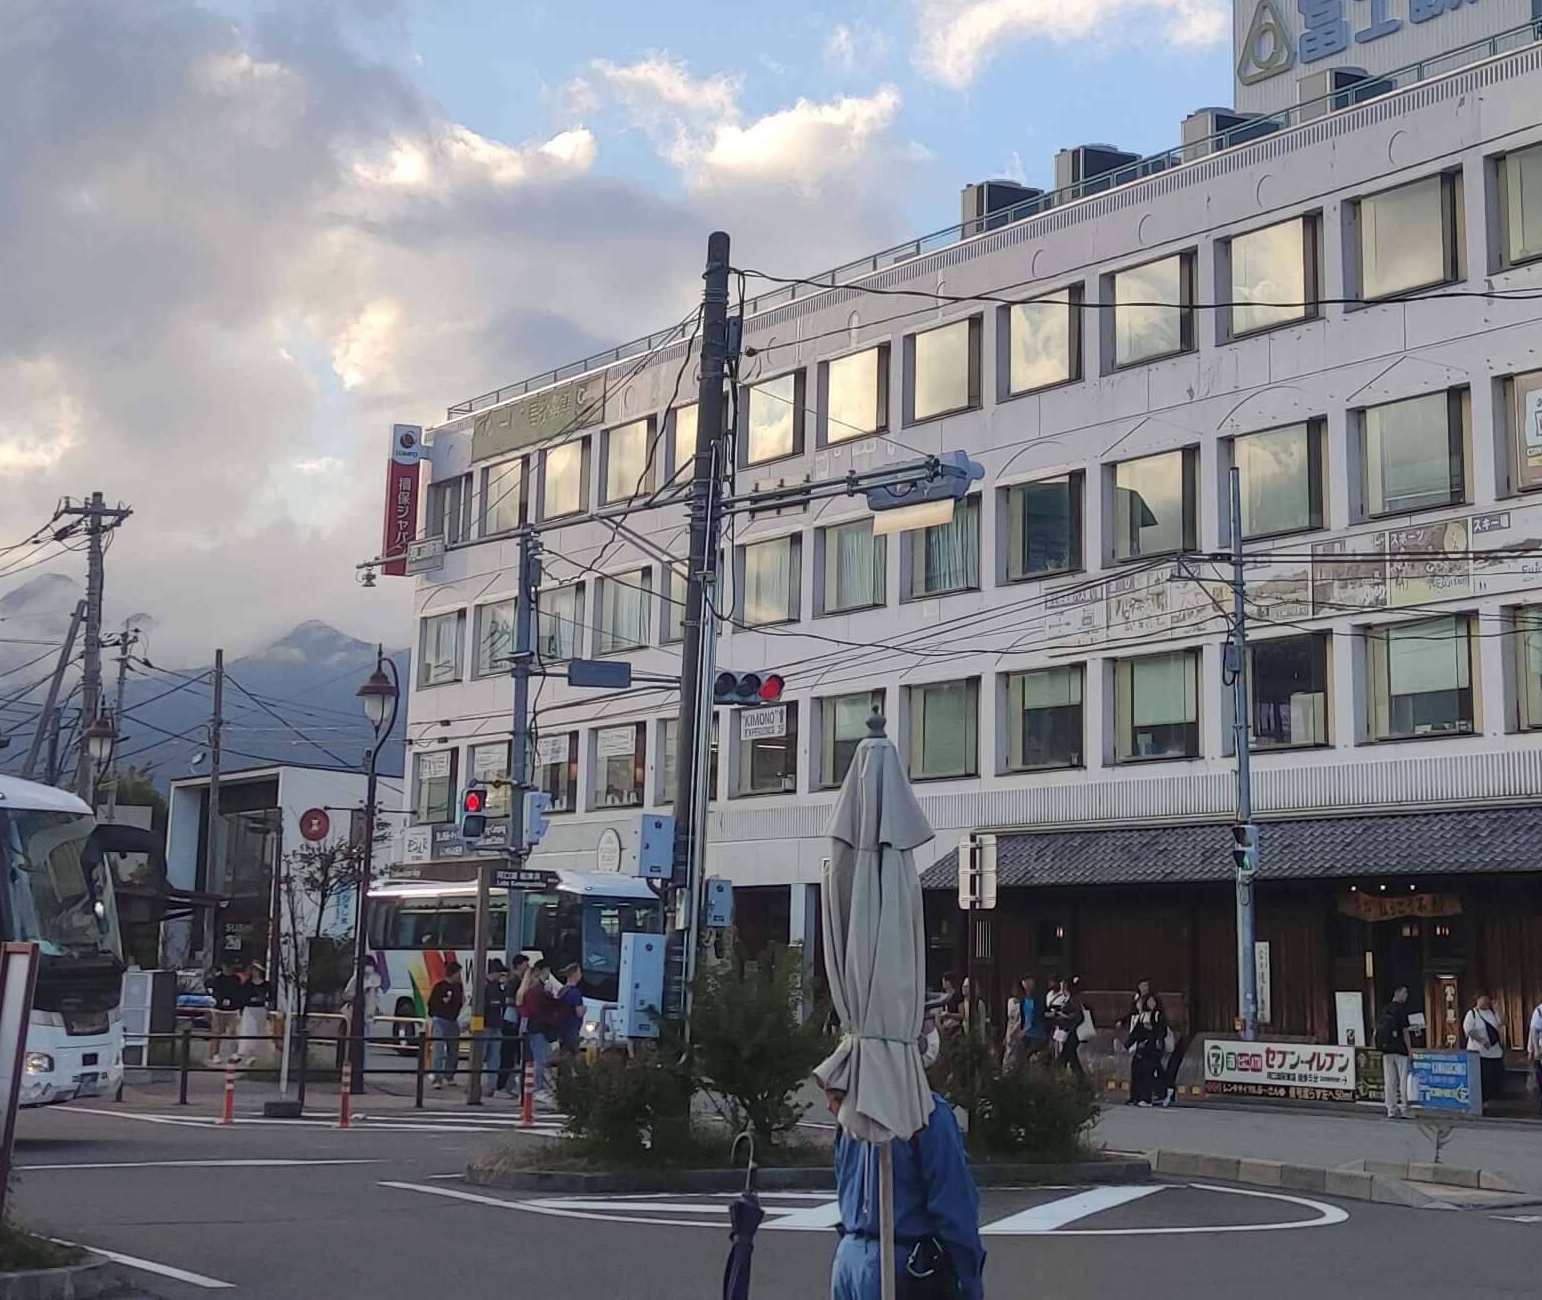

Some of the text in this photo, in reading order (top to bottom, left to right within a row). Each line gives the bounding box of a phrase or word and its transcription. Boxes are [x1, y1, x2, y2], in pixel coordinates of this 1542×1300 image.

[1390, 529, 1425, 545] スポーツ
[1266, 1047, 1350, 1073] セブン-イレブン
